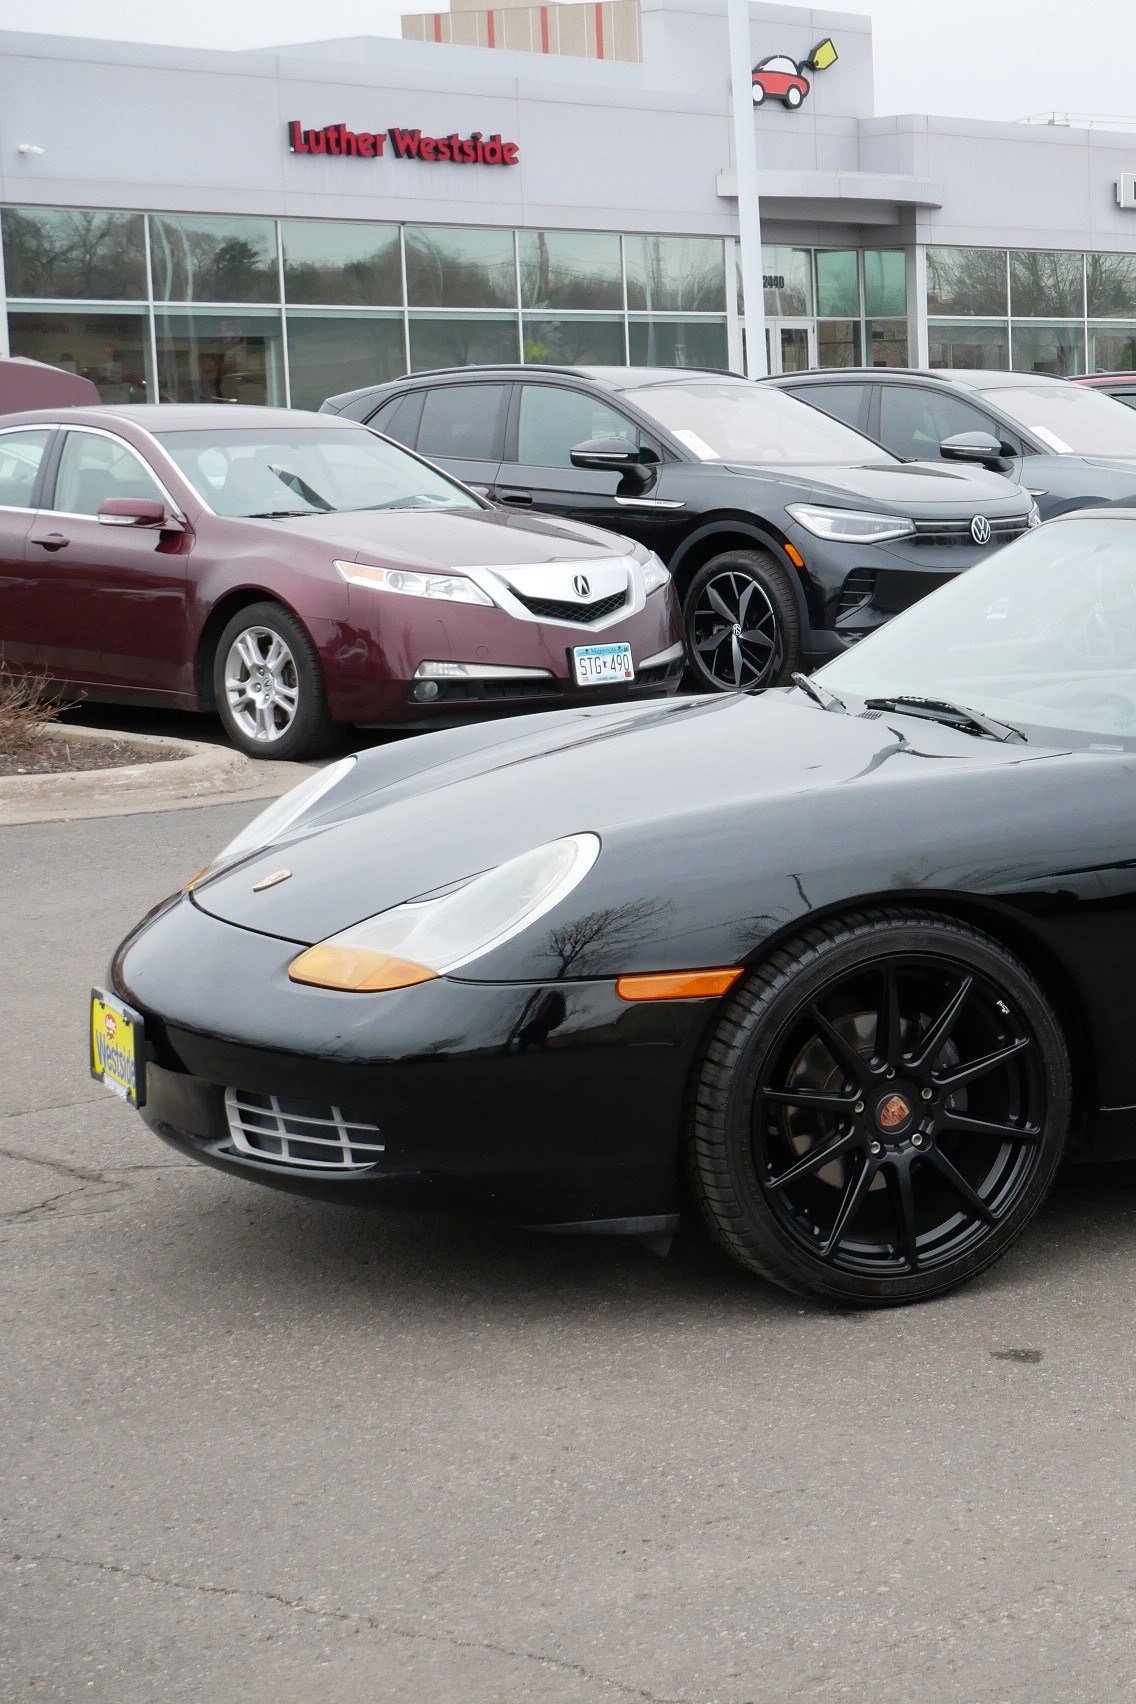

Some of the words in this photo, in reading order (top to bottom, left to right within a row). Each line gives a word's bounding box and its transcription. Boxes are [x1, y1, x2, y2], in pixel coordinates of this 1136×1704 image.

[288, 120, 387, 158] Luther
[388, 127, 520, 166] Westside
[579, 656, 602, 676] STG
[610, 653, 630, 673] 490
